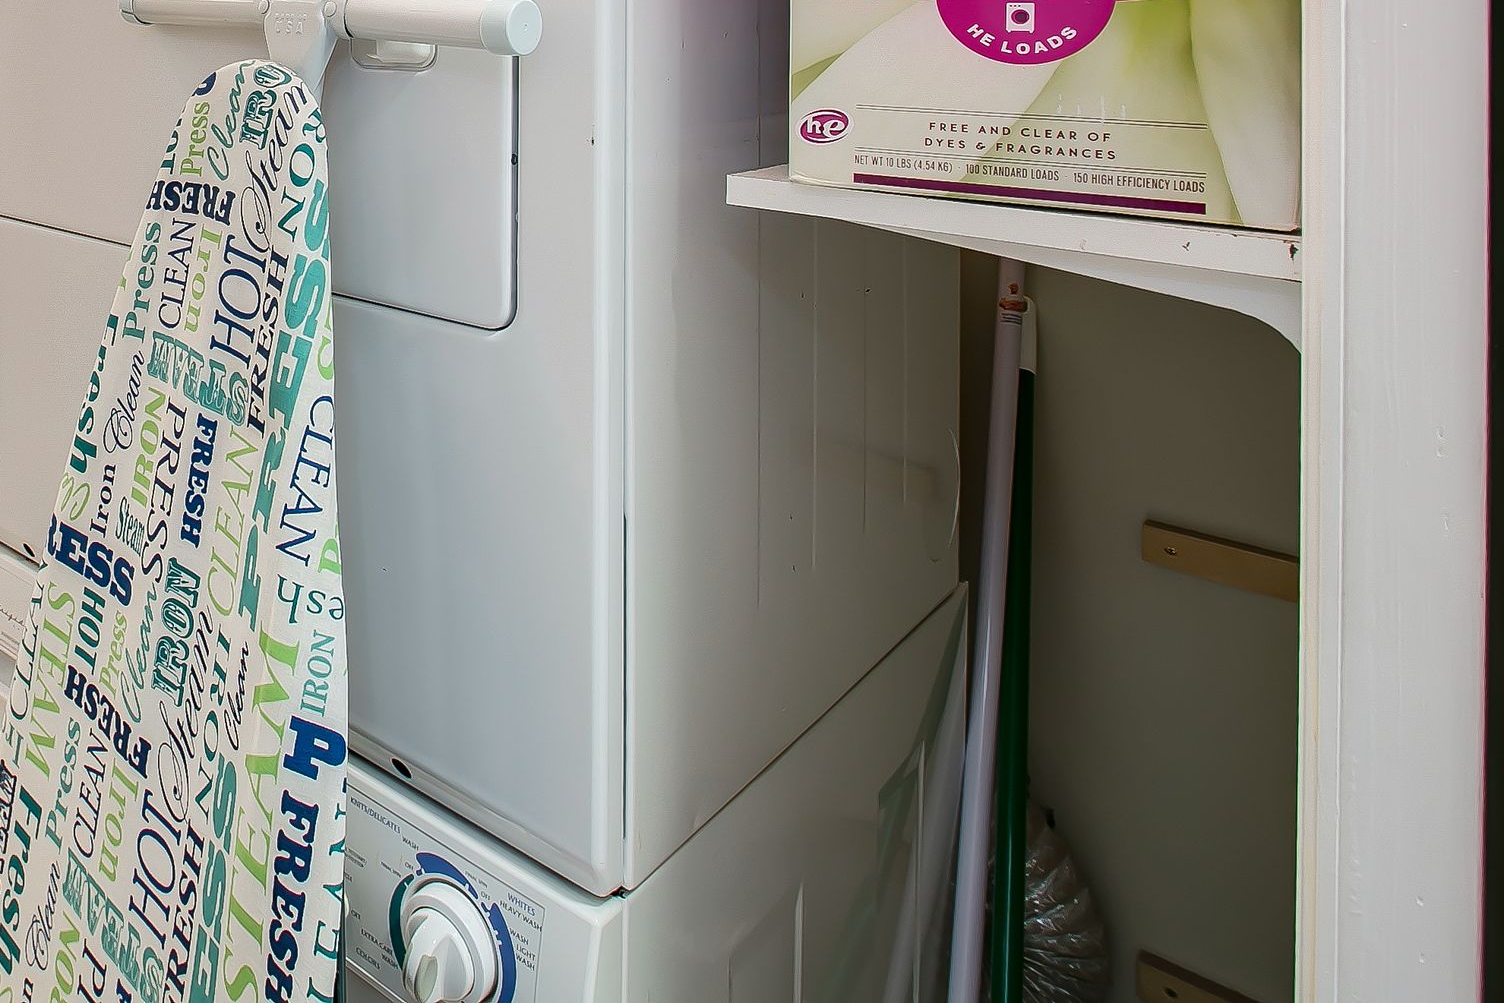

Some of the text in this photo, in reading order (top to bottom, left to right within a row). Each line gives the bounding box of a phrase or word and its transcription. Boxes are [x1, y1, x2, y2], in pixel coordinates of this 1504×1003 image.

[966, 23, 1078, 55] HE LOADS
[179, 101, 211, 178] Press
[207, 60, 256, 181] Clean
[239, 63, 296, 150] IRO
[924, 137, 1116, 160] DYES & FRAGRANCES
[929, 122, 1112, 143] FREE AND CLEAR OF
[145, 180, 237, 226] FRESH
[240, 81, 308, 254] Steam
[854, 154, 1205, 193] NET WT 10 LBS (4.54 KG) 100 STANDARD LOADS 150 HIGH EFFICIENCY LOADS
[122, 221, 163, 343] Press
[158, 217, 196, 330] CLEAN
[183, 224, 224, 334] Iron
[209, 233, 268, 370] HOT
[146, 329, 251, 427] STEAM
[246, 243, 290, 439] FRESH
[102, 350, 146, 455] Clean
[129, 385, 168, 509] IRON
[89, 464, 117, 538] Iron
[115, 496, 145, 558] Steam
[140, 395, 188, 583] PRESS
[178, 412, 219, 550] FRESH
[207, 425, 260, 617] CLEAN
[275, 394, 334, 567] CLEAN
[25, 581, 76, 781] STEAM
[72, 585, 107, 675] HOT
[98, 609, 129, 699] Press
[119, 582, 158, 723] Clean
[150, 557, 202, 708] IRON
[300, 629, 336, 718] IRON
[64, 663, 153, 779] FRESH
[156, 604, 215, 824] Steam
[194, 622, 232, 815] IRON
[223, 639, 250, 751] Clean
[45, 716, 83, 855] Press
[73, 726, 110, 859] CLEAN
[98, 756, 141, 883] Iron
[350, 796, 401, 835] KNITS/DELICATES
[128, 788, 183, 950] HOT
[402, 836, 420, 851] WASH
[24, 859, 62, 971] Clean
[499, 900, 543, 932] HEAVY WASH
[507, 892, 536, 917] WHITES
[509, 927, 530, 945] WASH
[516, 944, 537, 961] LIGHT
[515, 953, 536, 972] WASH
